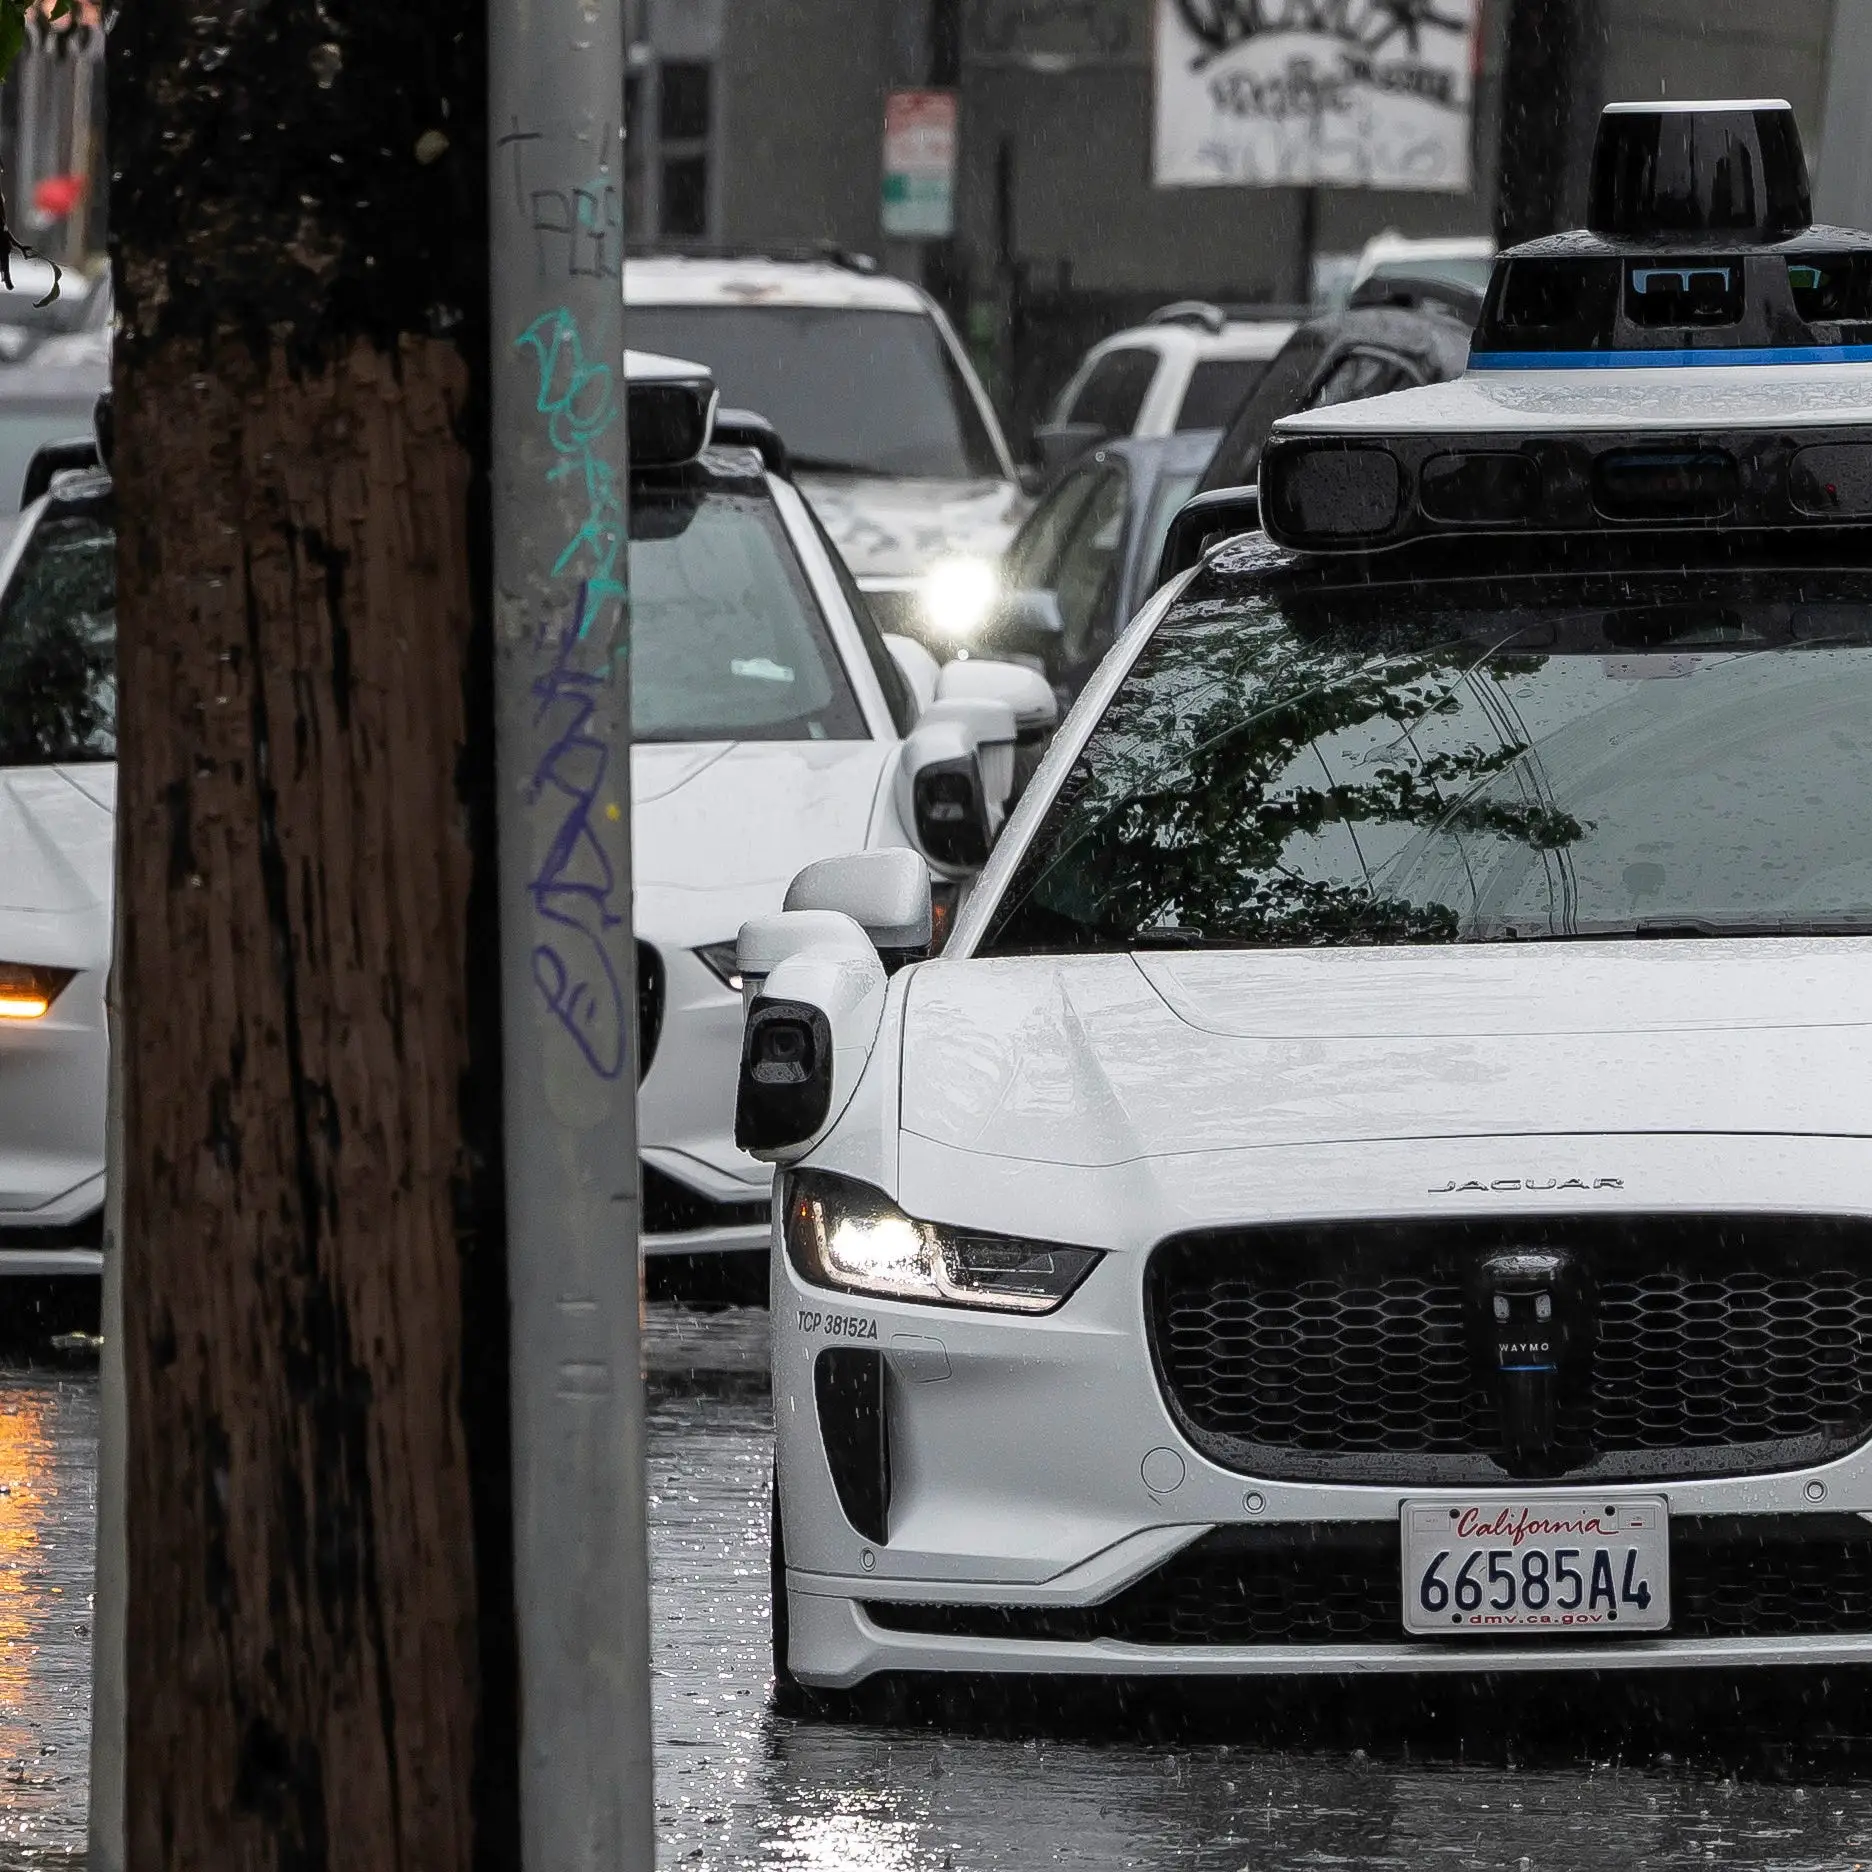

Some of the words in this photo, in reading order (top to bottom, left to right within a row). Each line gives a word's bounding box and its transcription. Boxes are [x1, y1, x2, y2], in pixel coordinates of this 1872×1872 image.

[1427, 1178, 1624, 1193] JAGUAR
[798, 1311, 821, 1333] TCP
[824, 1315, 878, 1340] 38152A
[1499, 1343, 1549, 1352] WAYMO
[1457, 1507, 1619, 1546] California
[1420, 1548, 1651, 1612] 66585A4
[1469, 1614, 1602, 1625] dmv.ca.gov
